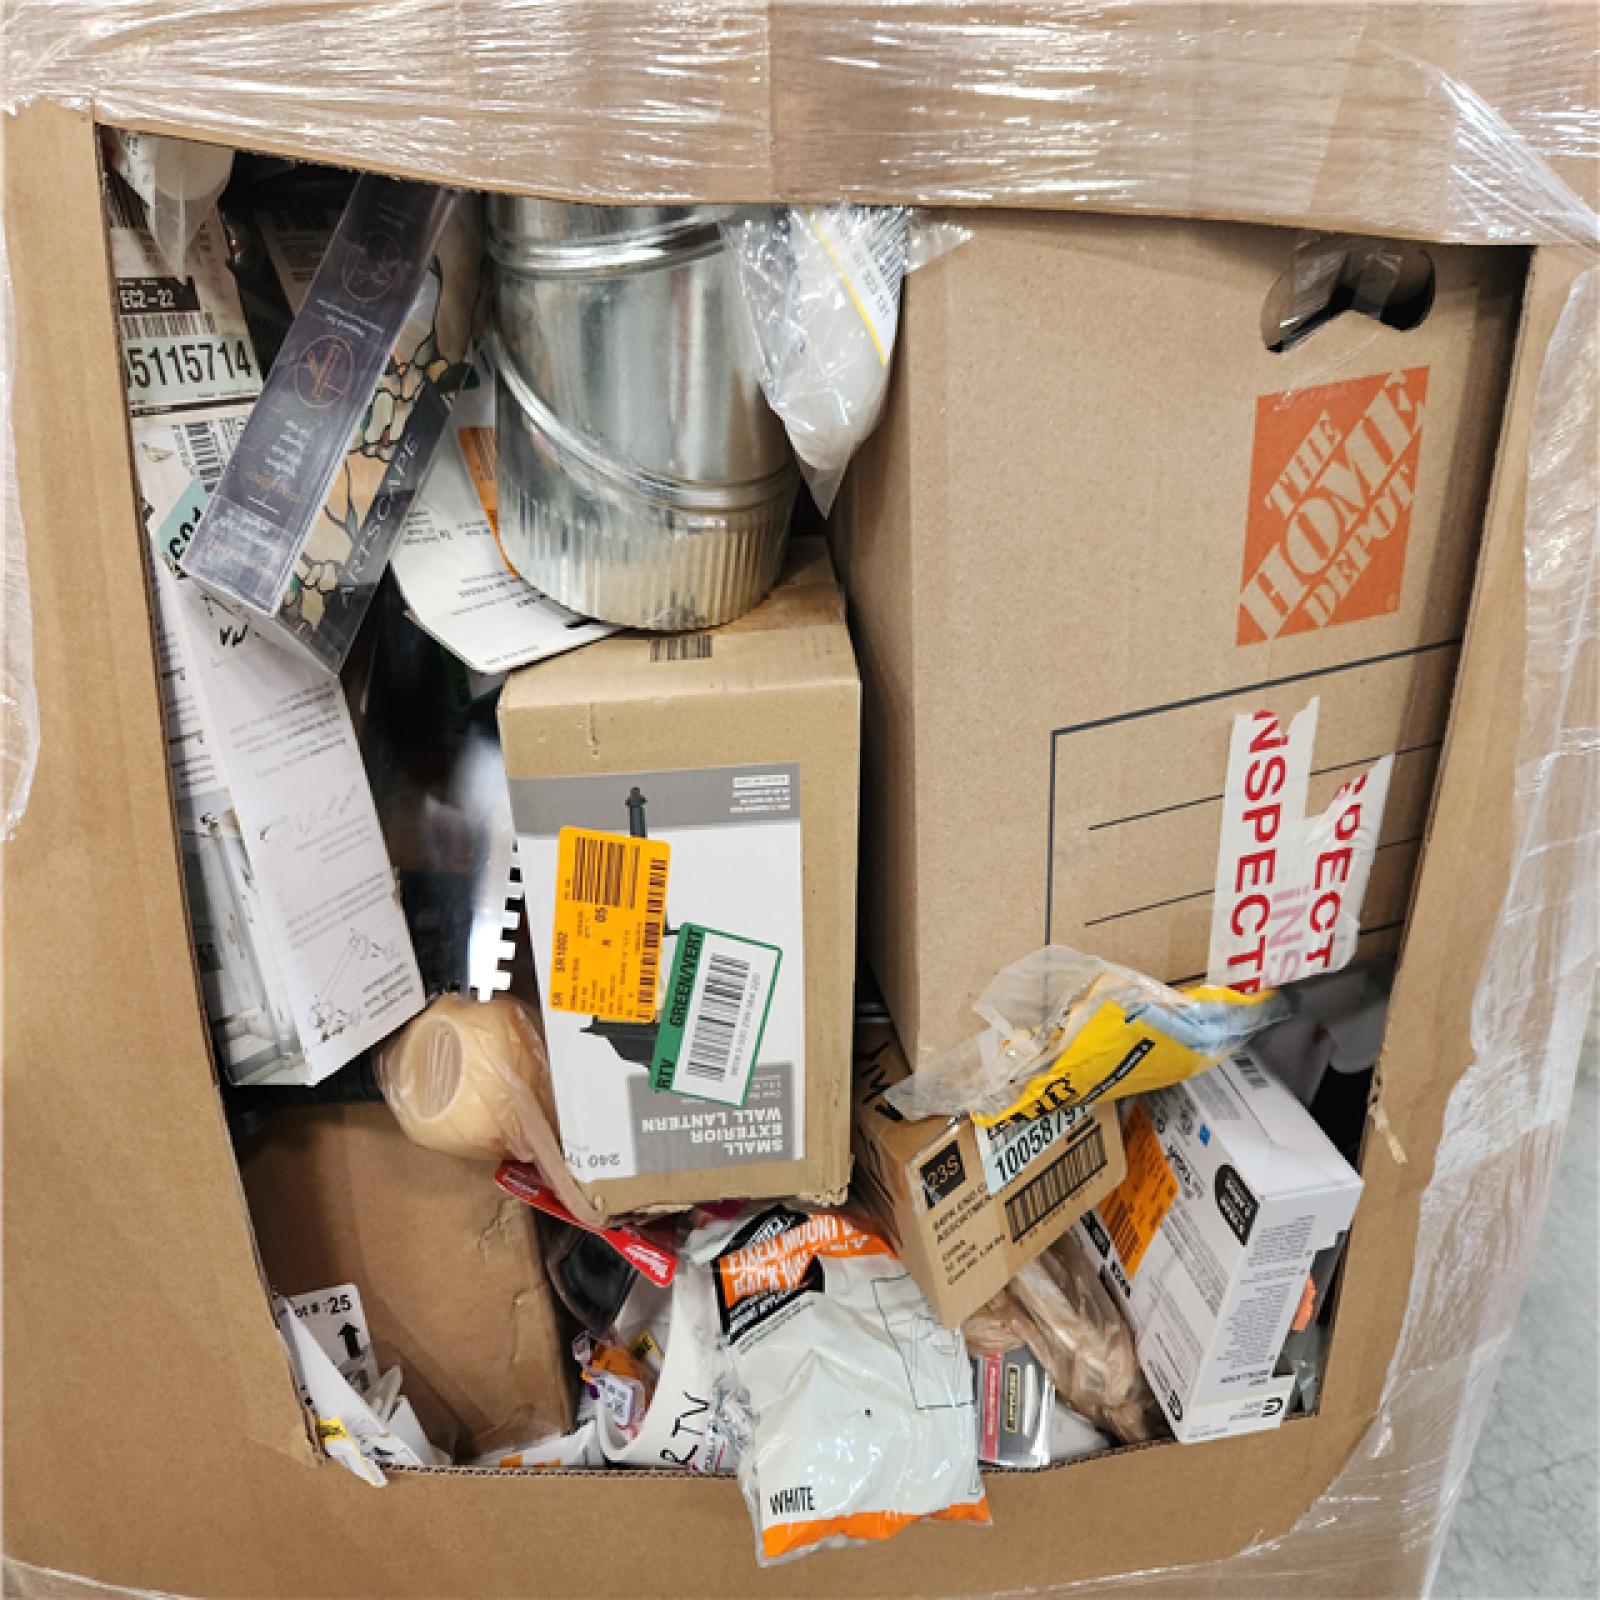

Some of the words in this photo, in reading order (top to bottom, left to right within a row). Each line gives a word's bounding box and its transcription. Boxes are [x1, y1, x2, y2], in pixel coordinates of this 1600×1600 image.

[127, 340, 252, 388] 5115714
[1264, 409, 1343, 520] THE
[338, 434, 420, 610] ARTSCAPE
[1240, 371, 1424, 640] HOME
[1302, 463, 1415, 628] DEPOT
[642, 1111, 727, 1133] LANTERN
[690, 1124, 783, 1143] EXTERIOR
[733, 1107, 782, 1125] WALL
[723, 1139, 783, 1156] SMALL
[937, 1193, 992, 1243] ASSORTMEN
[328, 1294, 352, 1316] 25
[658, 1389, 711, 1465] RTV
[769, 1486, 816, 1516] WHITE
